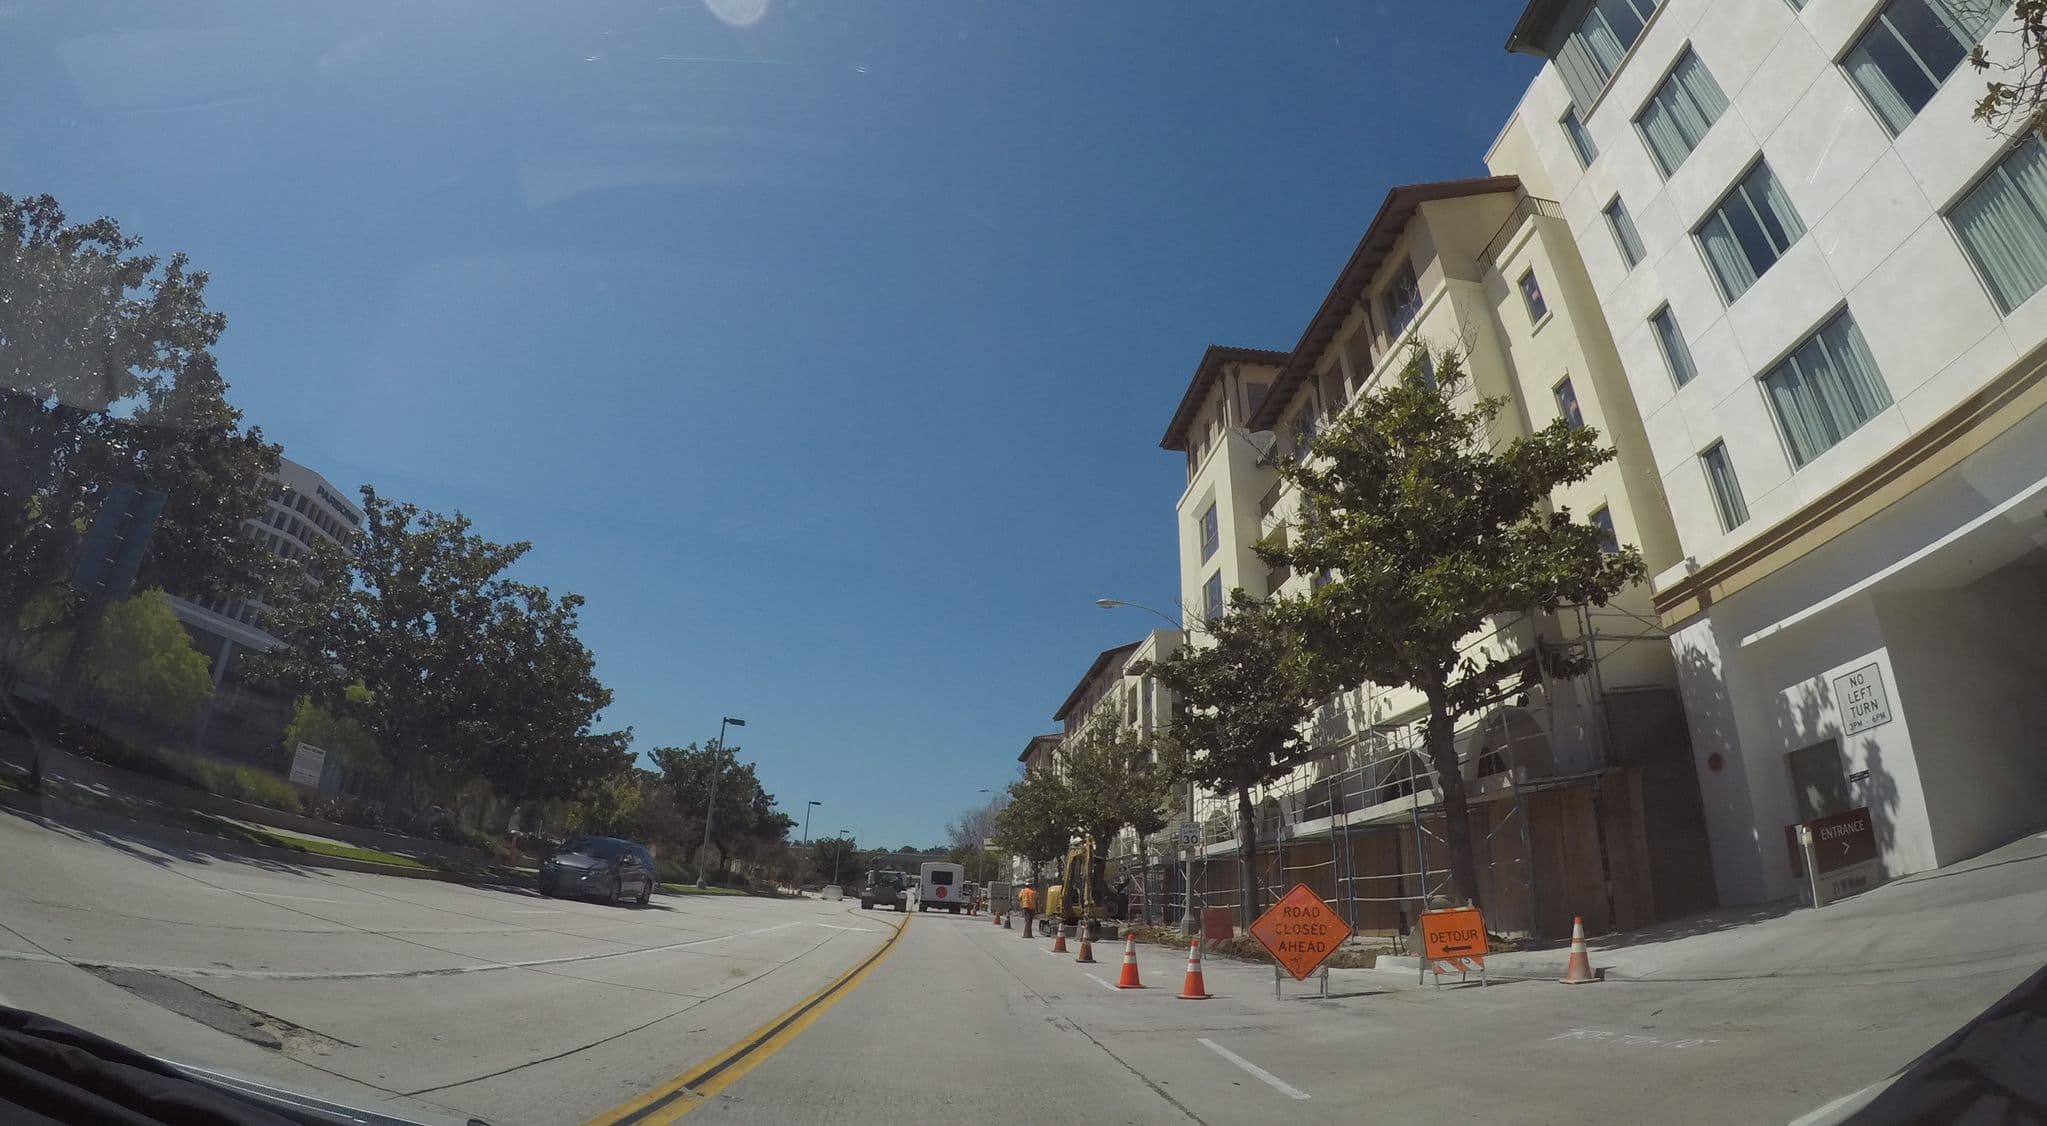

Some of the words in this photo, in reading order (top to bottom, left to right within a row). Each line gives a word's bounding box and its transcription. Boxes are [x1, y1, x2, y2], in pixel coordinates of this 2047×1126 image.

[1849, 673, 1865, 689] NO
[1847, 685, 1872, 704] LEFT
[1849, 698, 1879, 719] TURN
[1848, 720, 1863, 731] 3PM
[1821, 819, 1865, 841] ENTRANCE
[1183, 835, 1198, 844] 30
[1283, 906, 1321, 918] ROAD
[1275, 923, 1328, 936] CLOSED
[1430, 929, 1478, 943] DETOUR
[1279, 941, 1326, 953] AHEAD
